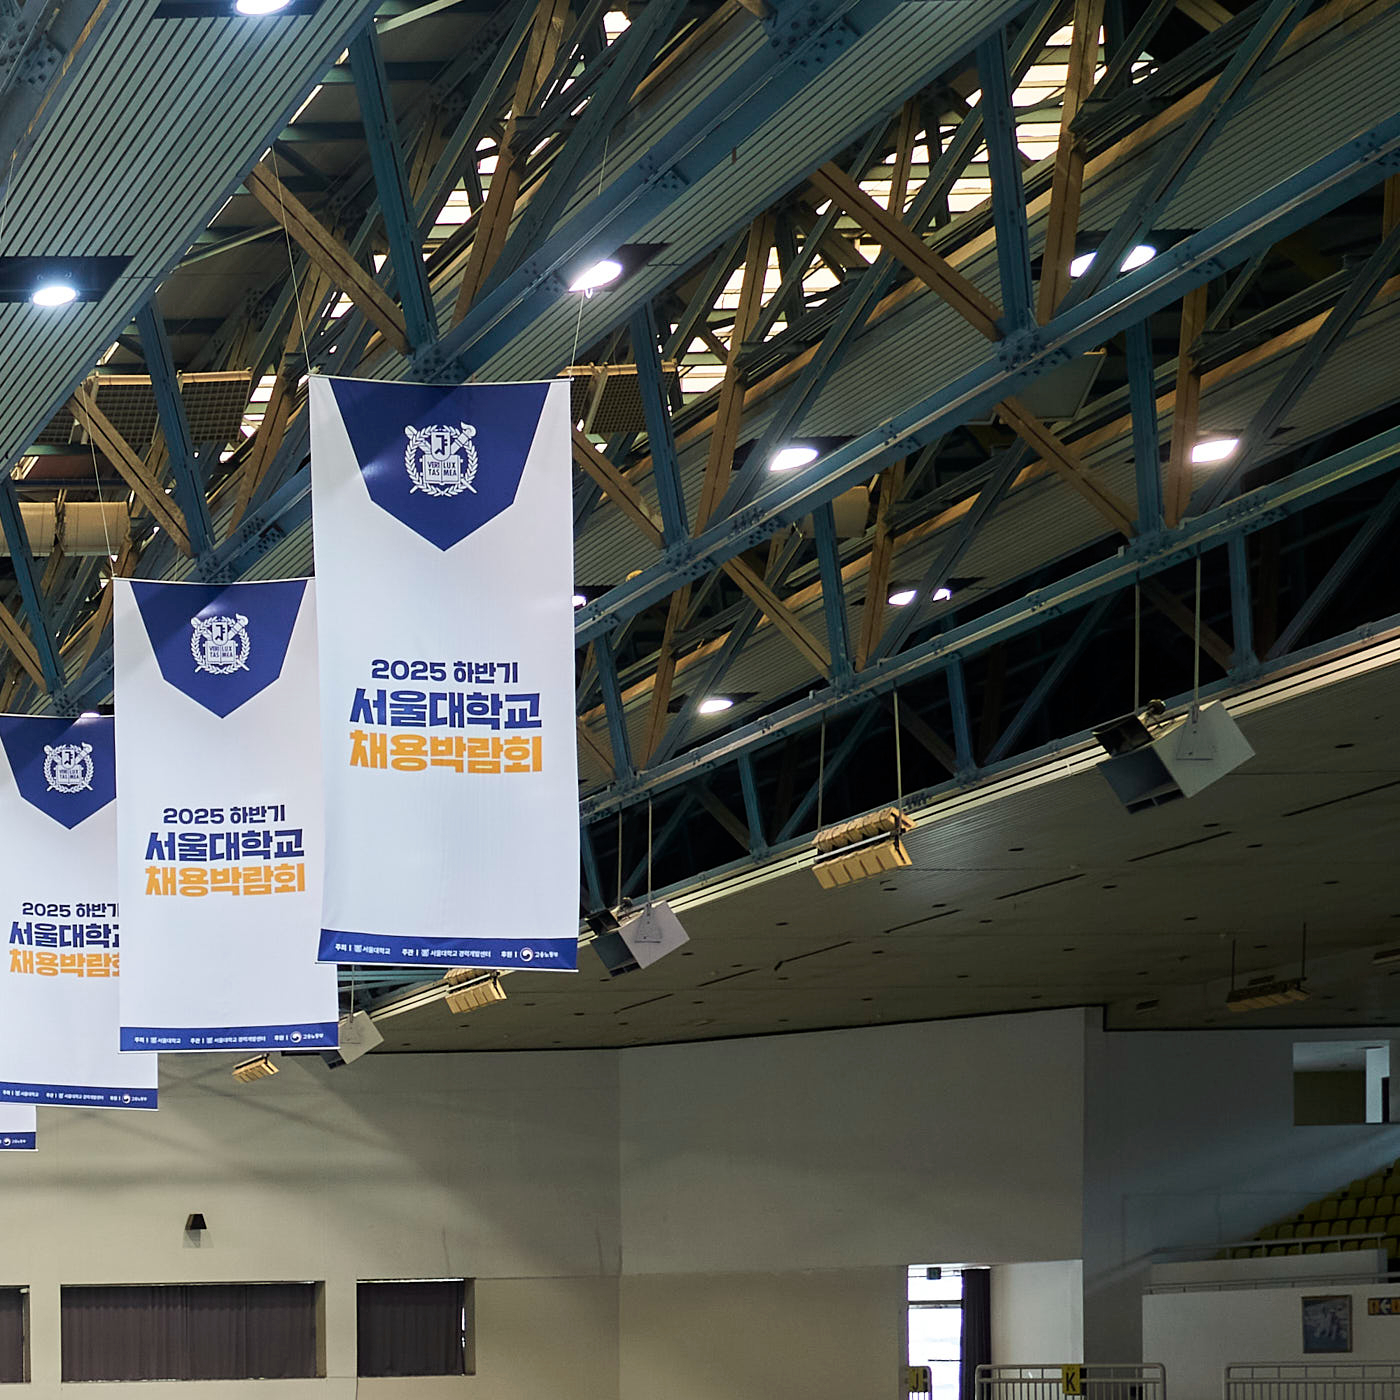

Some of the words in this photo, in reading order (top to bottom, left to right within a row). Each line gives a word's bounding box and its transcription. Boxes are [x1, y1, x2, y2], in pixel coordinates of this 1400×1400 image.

[372, 660, 446, 681] 2025
[452, 661, 518, 684] 하반기
[349, 689, 541, 730] 서울대학교
[349, 730, 542, 774] 채용박람회
[1065, 1374, 1077, 1393] K
